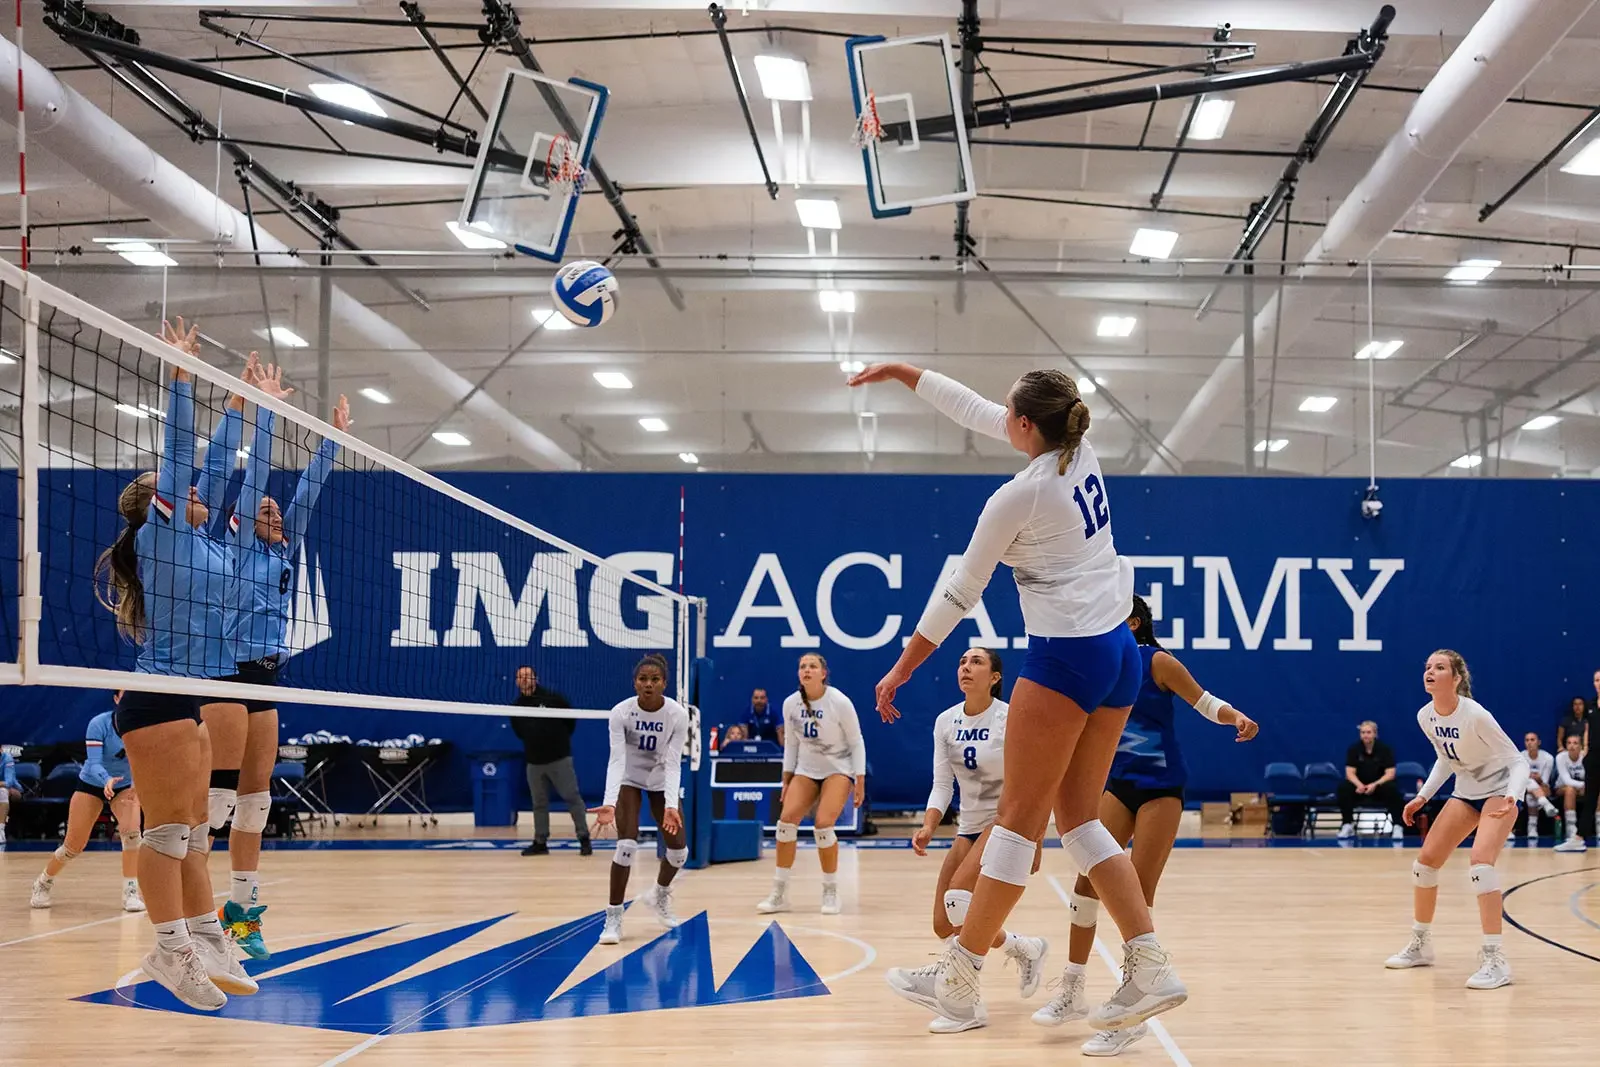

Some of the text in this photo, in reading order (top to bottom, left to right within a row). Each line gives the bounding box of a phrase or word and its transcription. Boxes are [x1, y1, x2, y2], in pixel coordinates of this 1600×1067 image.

[1073, 473, 1110, 540] 12
[390, 551, 1405, 652] IMG ACAEMY
[635, 720, 664, 733] IMG
[803, 722, 819, 739] 16
[955, 728, 990, 741] IMG
[1435, 726, 1460, 739] IMG
[638, 735, 657, 751] 10
[963, 746, 978, 770] 8
[1442, 742, 1460, 762] 11
